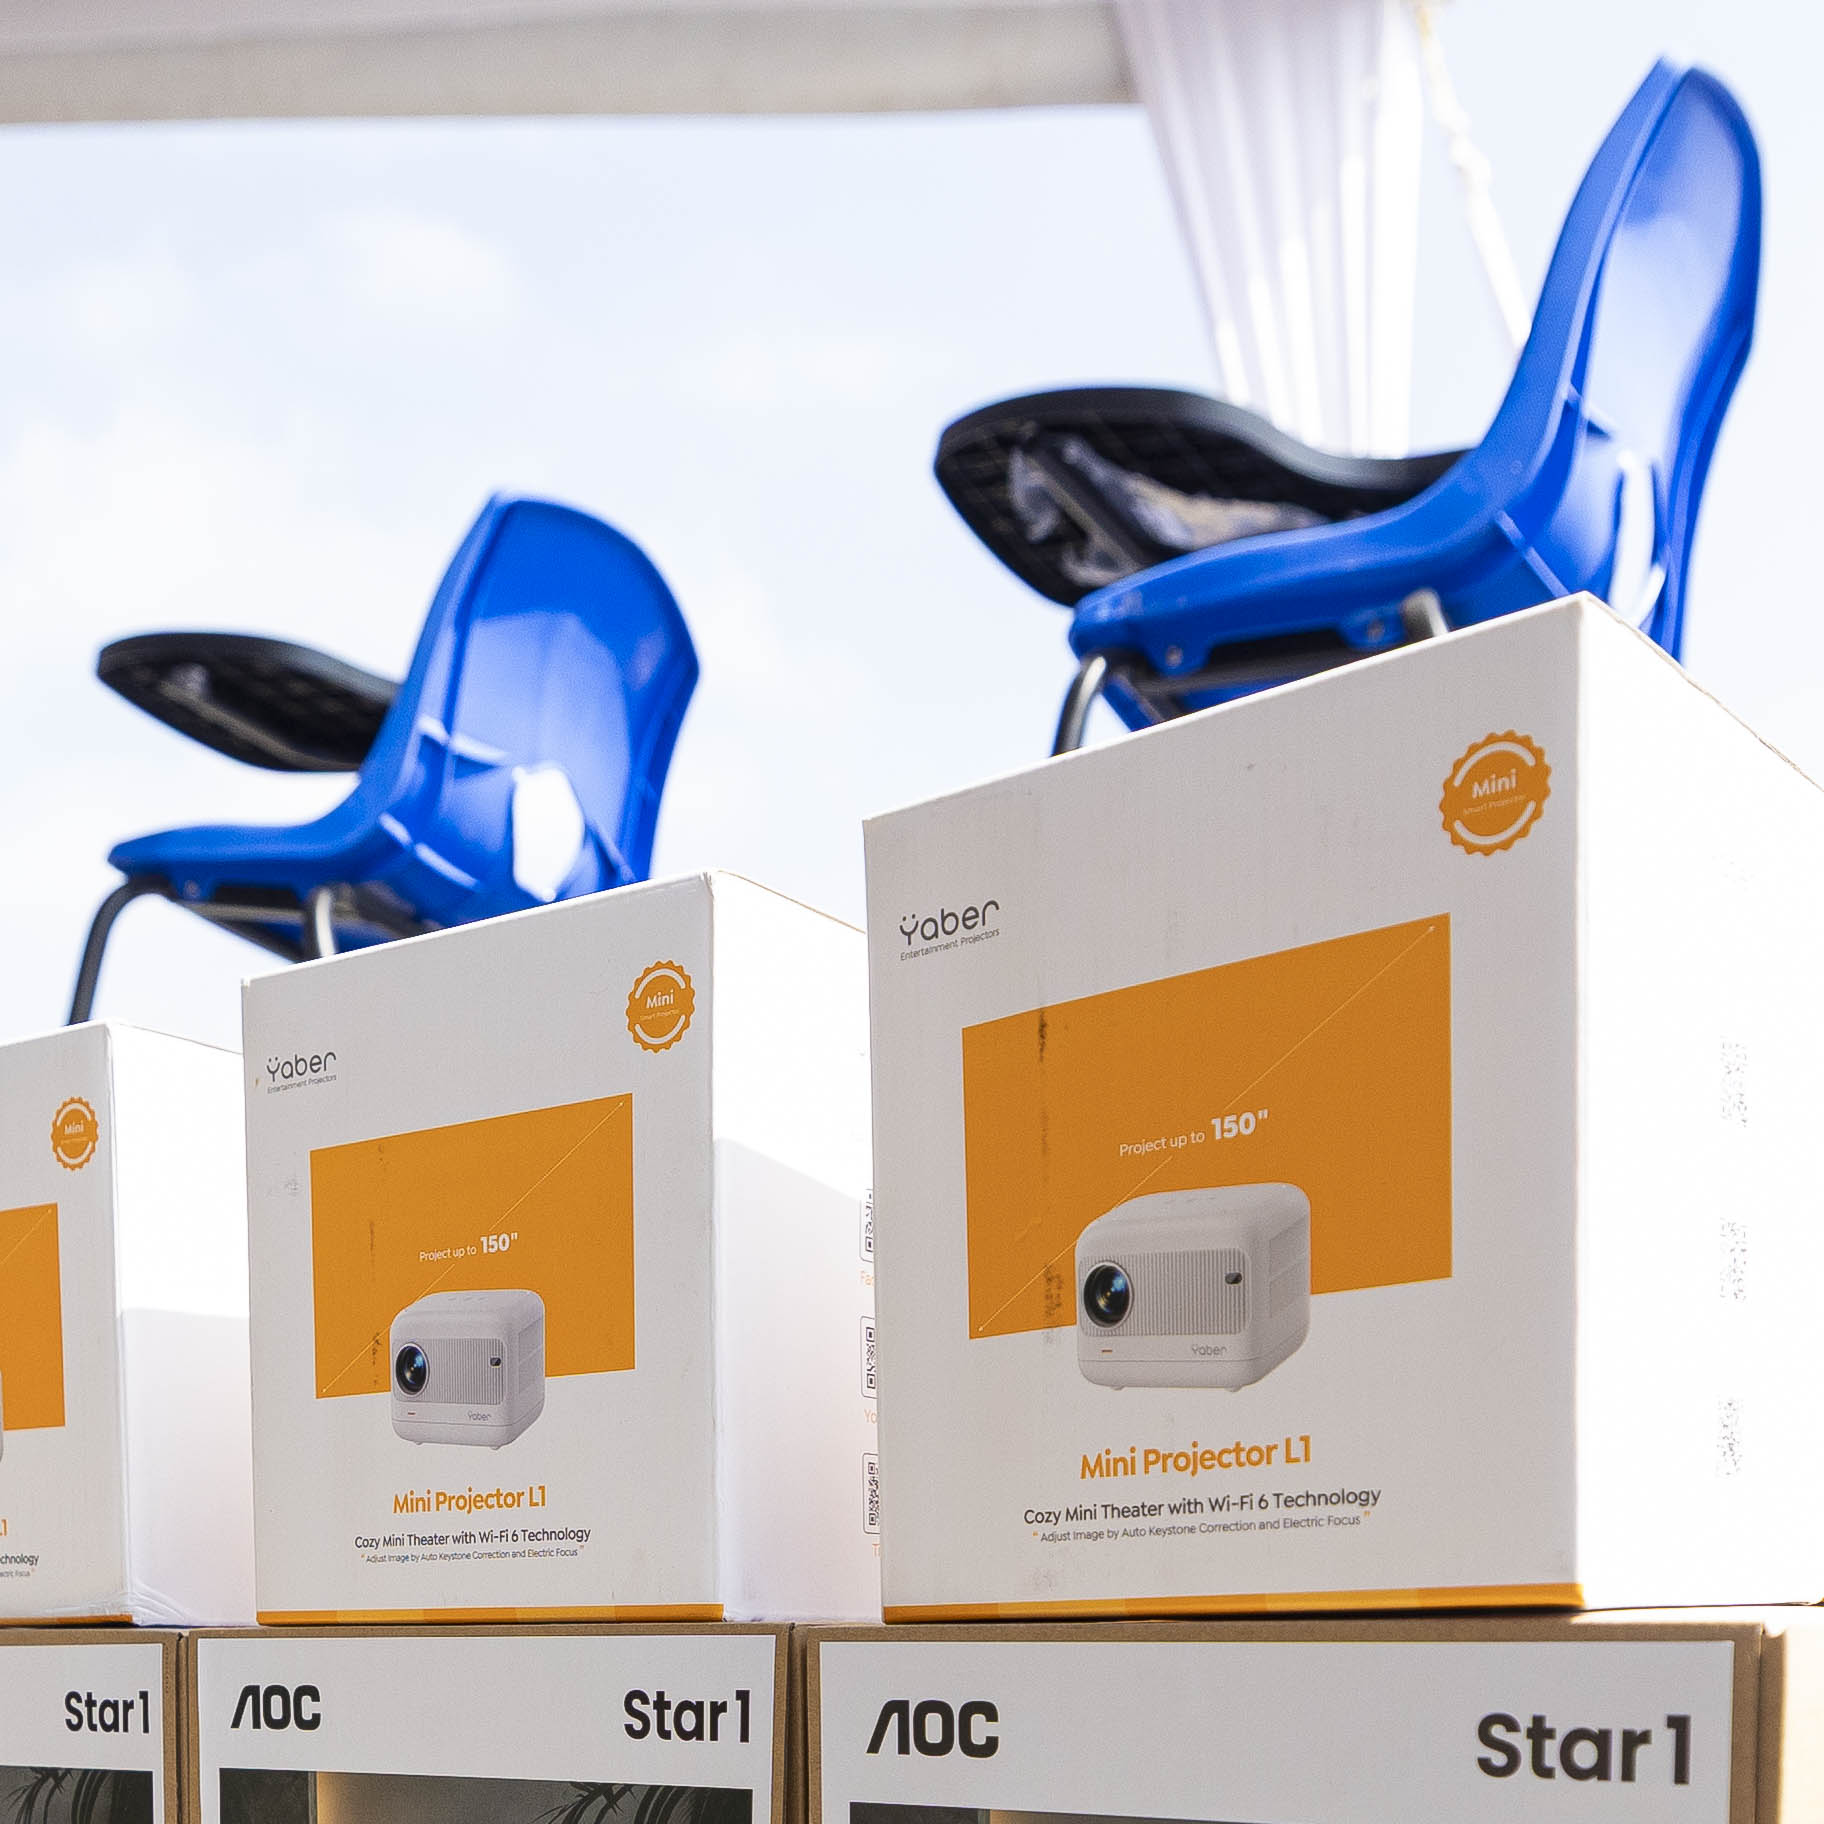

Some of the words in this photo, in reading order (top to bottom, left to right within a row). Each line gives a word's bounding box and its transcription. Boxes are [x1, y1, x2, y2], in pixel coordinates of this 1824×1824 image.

[1472, 768, 1517, 799] Mini
[900, 940, 959, 961] Entertainment
[961, 928, 1001, 946] Projectors
[646, 988, 674, 1008] Mini
[64, 1120, 84, 1135] Mini
[1119, 1137, 1167, 1157] Project
[1169, 1134, 1188, 1149] up
[1190, 1131, 1205, 1144] to
[419, 1248, 451, 1262] Project
[453, 1248, 465, 1259] up
[467, 1245, 477, 1255] to
[1081, 1446, 1136, 1480] Mini
[1144, 1441, 1278, 1478] Projector
[1285, 1435, 1311, 1465] L1
[392, 1489, 431, 1514] Mini
[435, 1487, 525, 1514] Projector
[529, 1485, 546, 1508] L1
[1023, 1508, 1062, 1527] Cozy
[1064, 1503, 1098, 1522] Mini
[1100, 1501, 1165, 1520] Theater
[1167, 1497, 1205, 1516] with
[1207, 1492, 1254, 1513] Wi-Fi
[1257, 1493, 1270, 1511] 6
[1272, 1488, 1382, 1509] Technology
[355, 1536, 381, 1550] Cozy
[382, 1533, 405, 1547] Mini
[407, 1534, 450, 1547] Theater
[452, 1530, 476, 1544] with
[478, 1528, 509, 1543] Wi-Fi
[511, 1530, 519, 1543] 6
[521, 1527, 591, 1543] Technology
[1040, 1531, 1071, 1545] Adjust
[1073, 1530, 1104, 1543] Image
[1106, 1528, 1120, 1541] by
[1121, 1527, 1147, 1539] Auto
[1148, 1524, 1197, 1538] Keystone
[1198, 1521, 1257, 1534] Correction
[1258, 1519, 1281, 1531] and
[1282, 1517, 1325, 1529] Electric
[1327, 1514, 1361, 1527] Focus
[231, 1684, 322, 1730] AOC
[866, 1698, 1000, 1758] AOC
